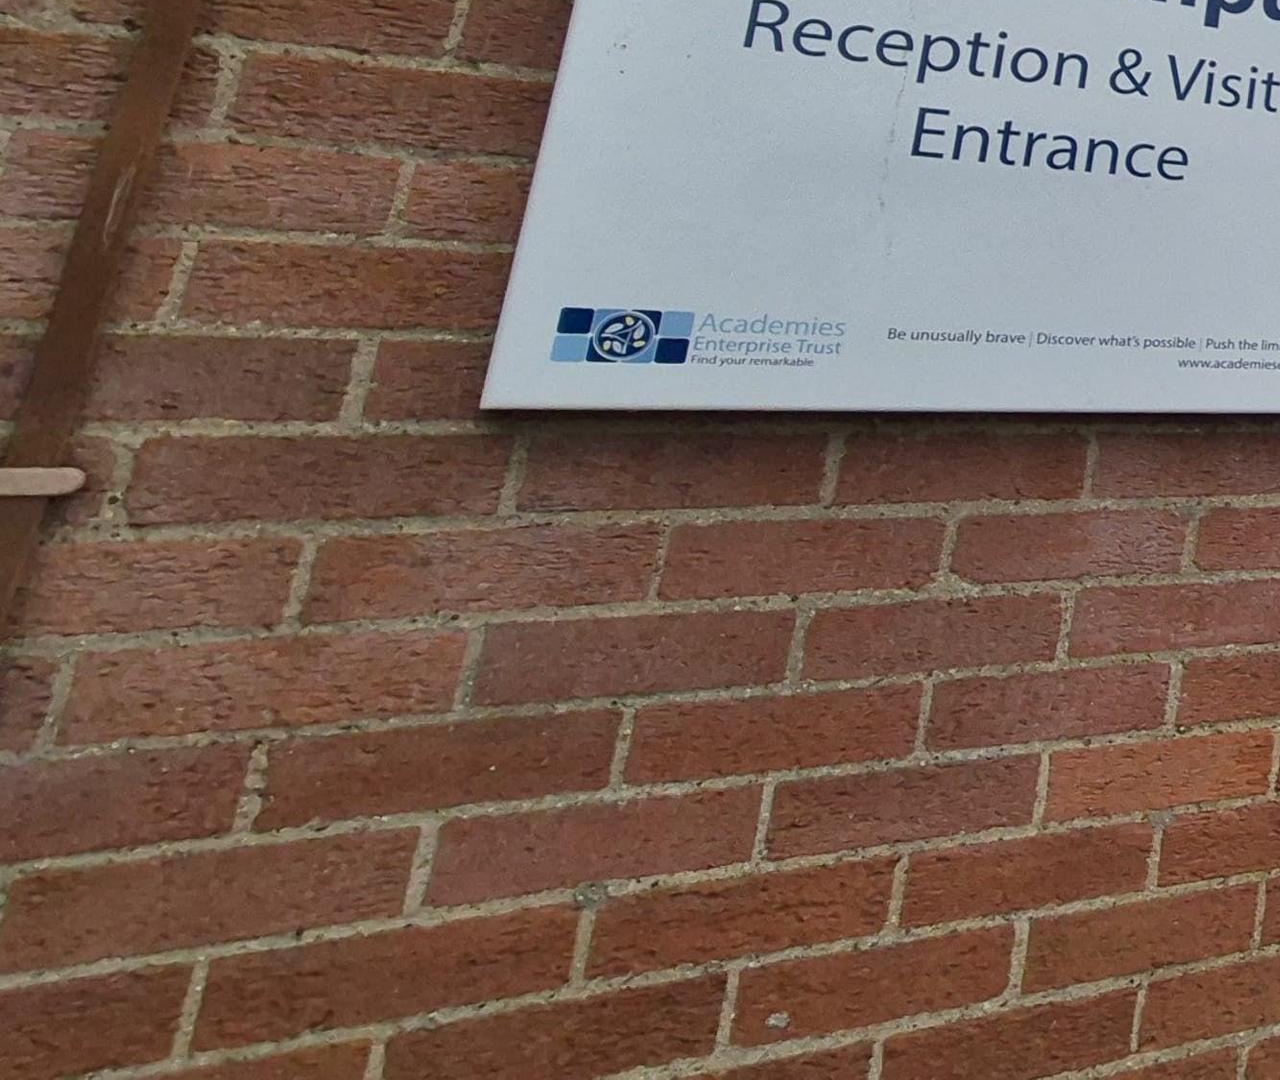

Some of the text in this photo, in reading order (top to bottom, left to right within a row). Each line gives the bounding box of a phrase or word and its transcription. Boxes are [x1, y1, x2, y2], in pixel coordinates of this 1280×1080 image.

[1109, 48, 1152, 97] &
[910, 107, 1190, 181] Entrance
[698, 312, 845, 336] Academies
[694, 336, 841, 355] Enterprise Trust
[887, 327, 906, 340] Be
[910, 329, 982, 345] unusually
[985, 330, 1026, 344] brave
[1037, 332, 1095, 346] Discover
[1143, 336, 1196, 350] possible
[1205, 338, 1235, 350] Push
[1238, 339, 1258, 351] the
[690, 355, 814, 368] Find your remarkable
